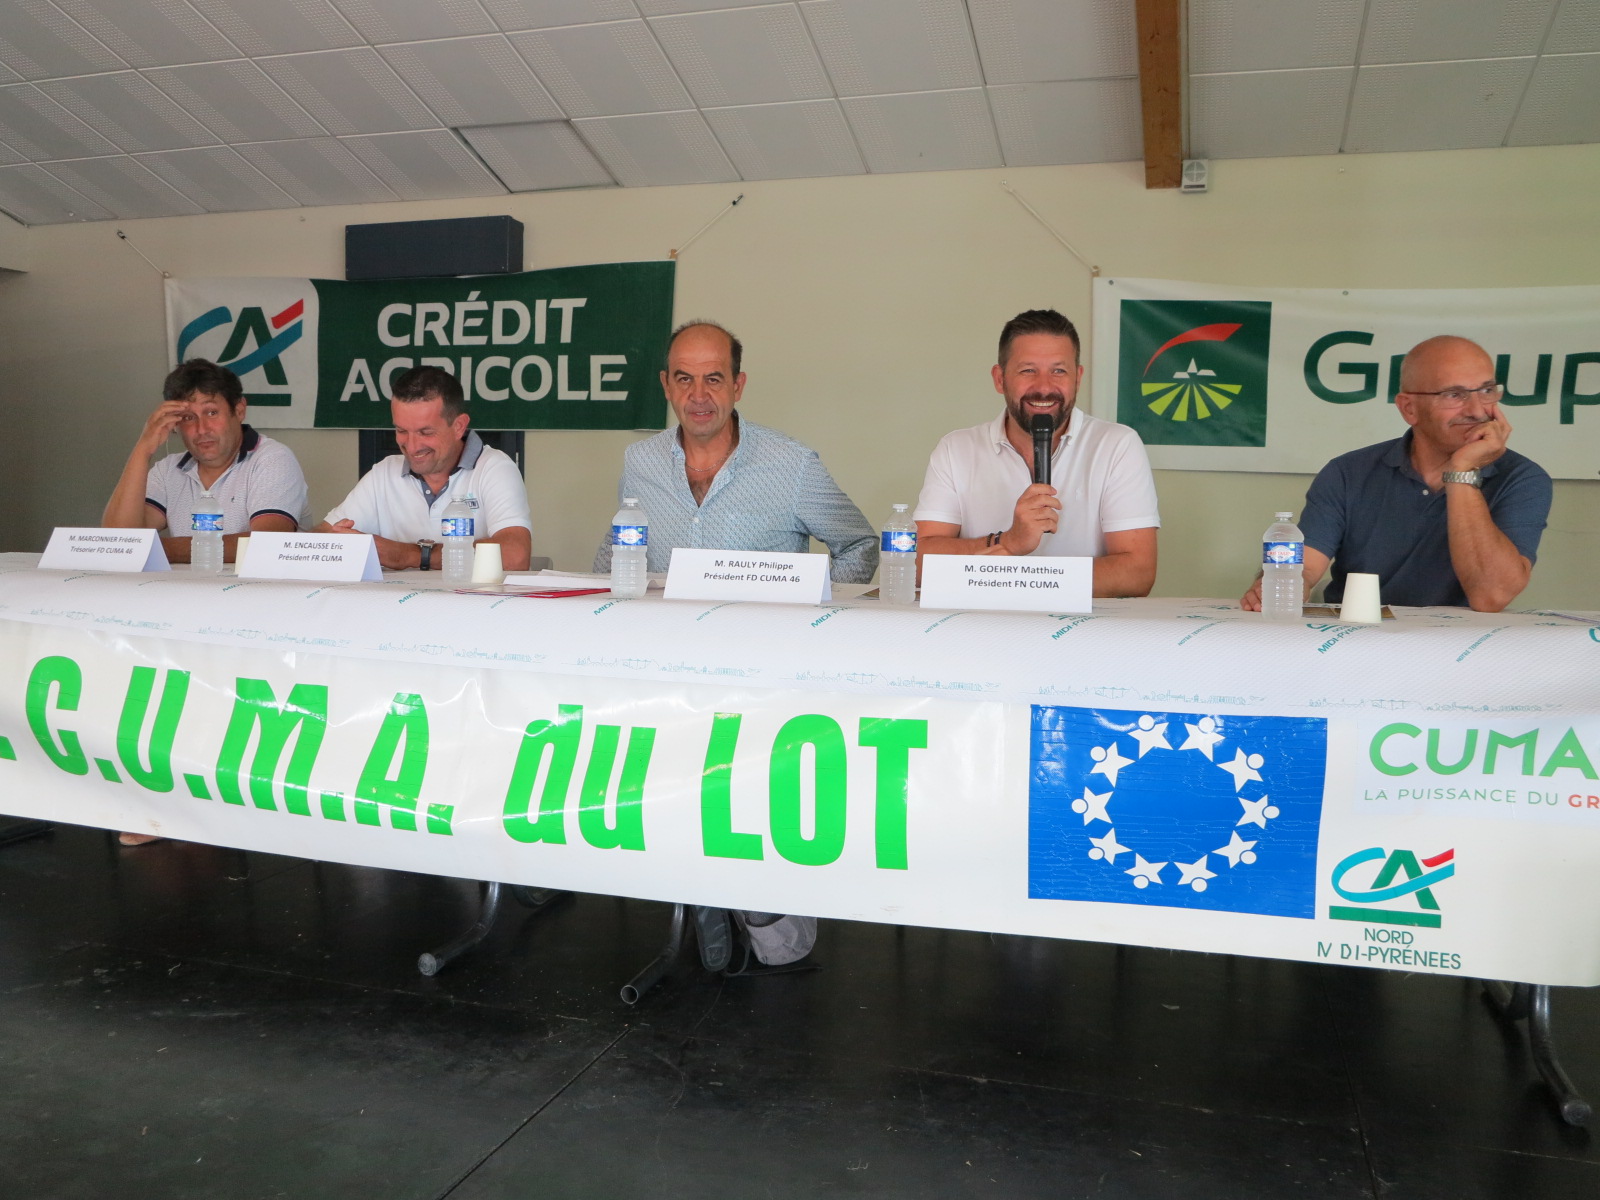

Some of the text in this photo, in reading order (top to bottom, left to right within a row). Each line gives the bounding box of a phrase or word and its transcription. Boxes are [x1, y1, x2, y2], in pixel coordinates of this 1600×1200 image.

[377, 291, 588, 347] CRÉDIT
[78, 535, 118, 543] MARCONNIER
[294, 542, 329, 550] ENCAUSSE
[330, 542, 343, 550] Eric
[278, 553, 310, 561] Président
[728, 560, 757, 568] RAULY
[758, 561, 794, 571] Philippe
[964, 564, 1065, 575] M. GOEHRY Matthieu
[703, 572, 801, 583] Président FD CUMA 46
[968, 578, 1060, 589] Président FN CUMA
[1369, 722, 1600, 780] CUMA
[502, 704, 657, 851] du
[701, 712, 928, 870] LOT
[1364, 789, 1388, 801] LA
[1398, 788, 1517, 803] PUISSANCE
[1528, 791, 1559, 806] DU
[1364, 928, 1414, 945] NORD
